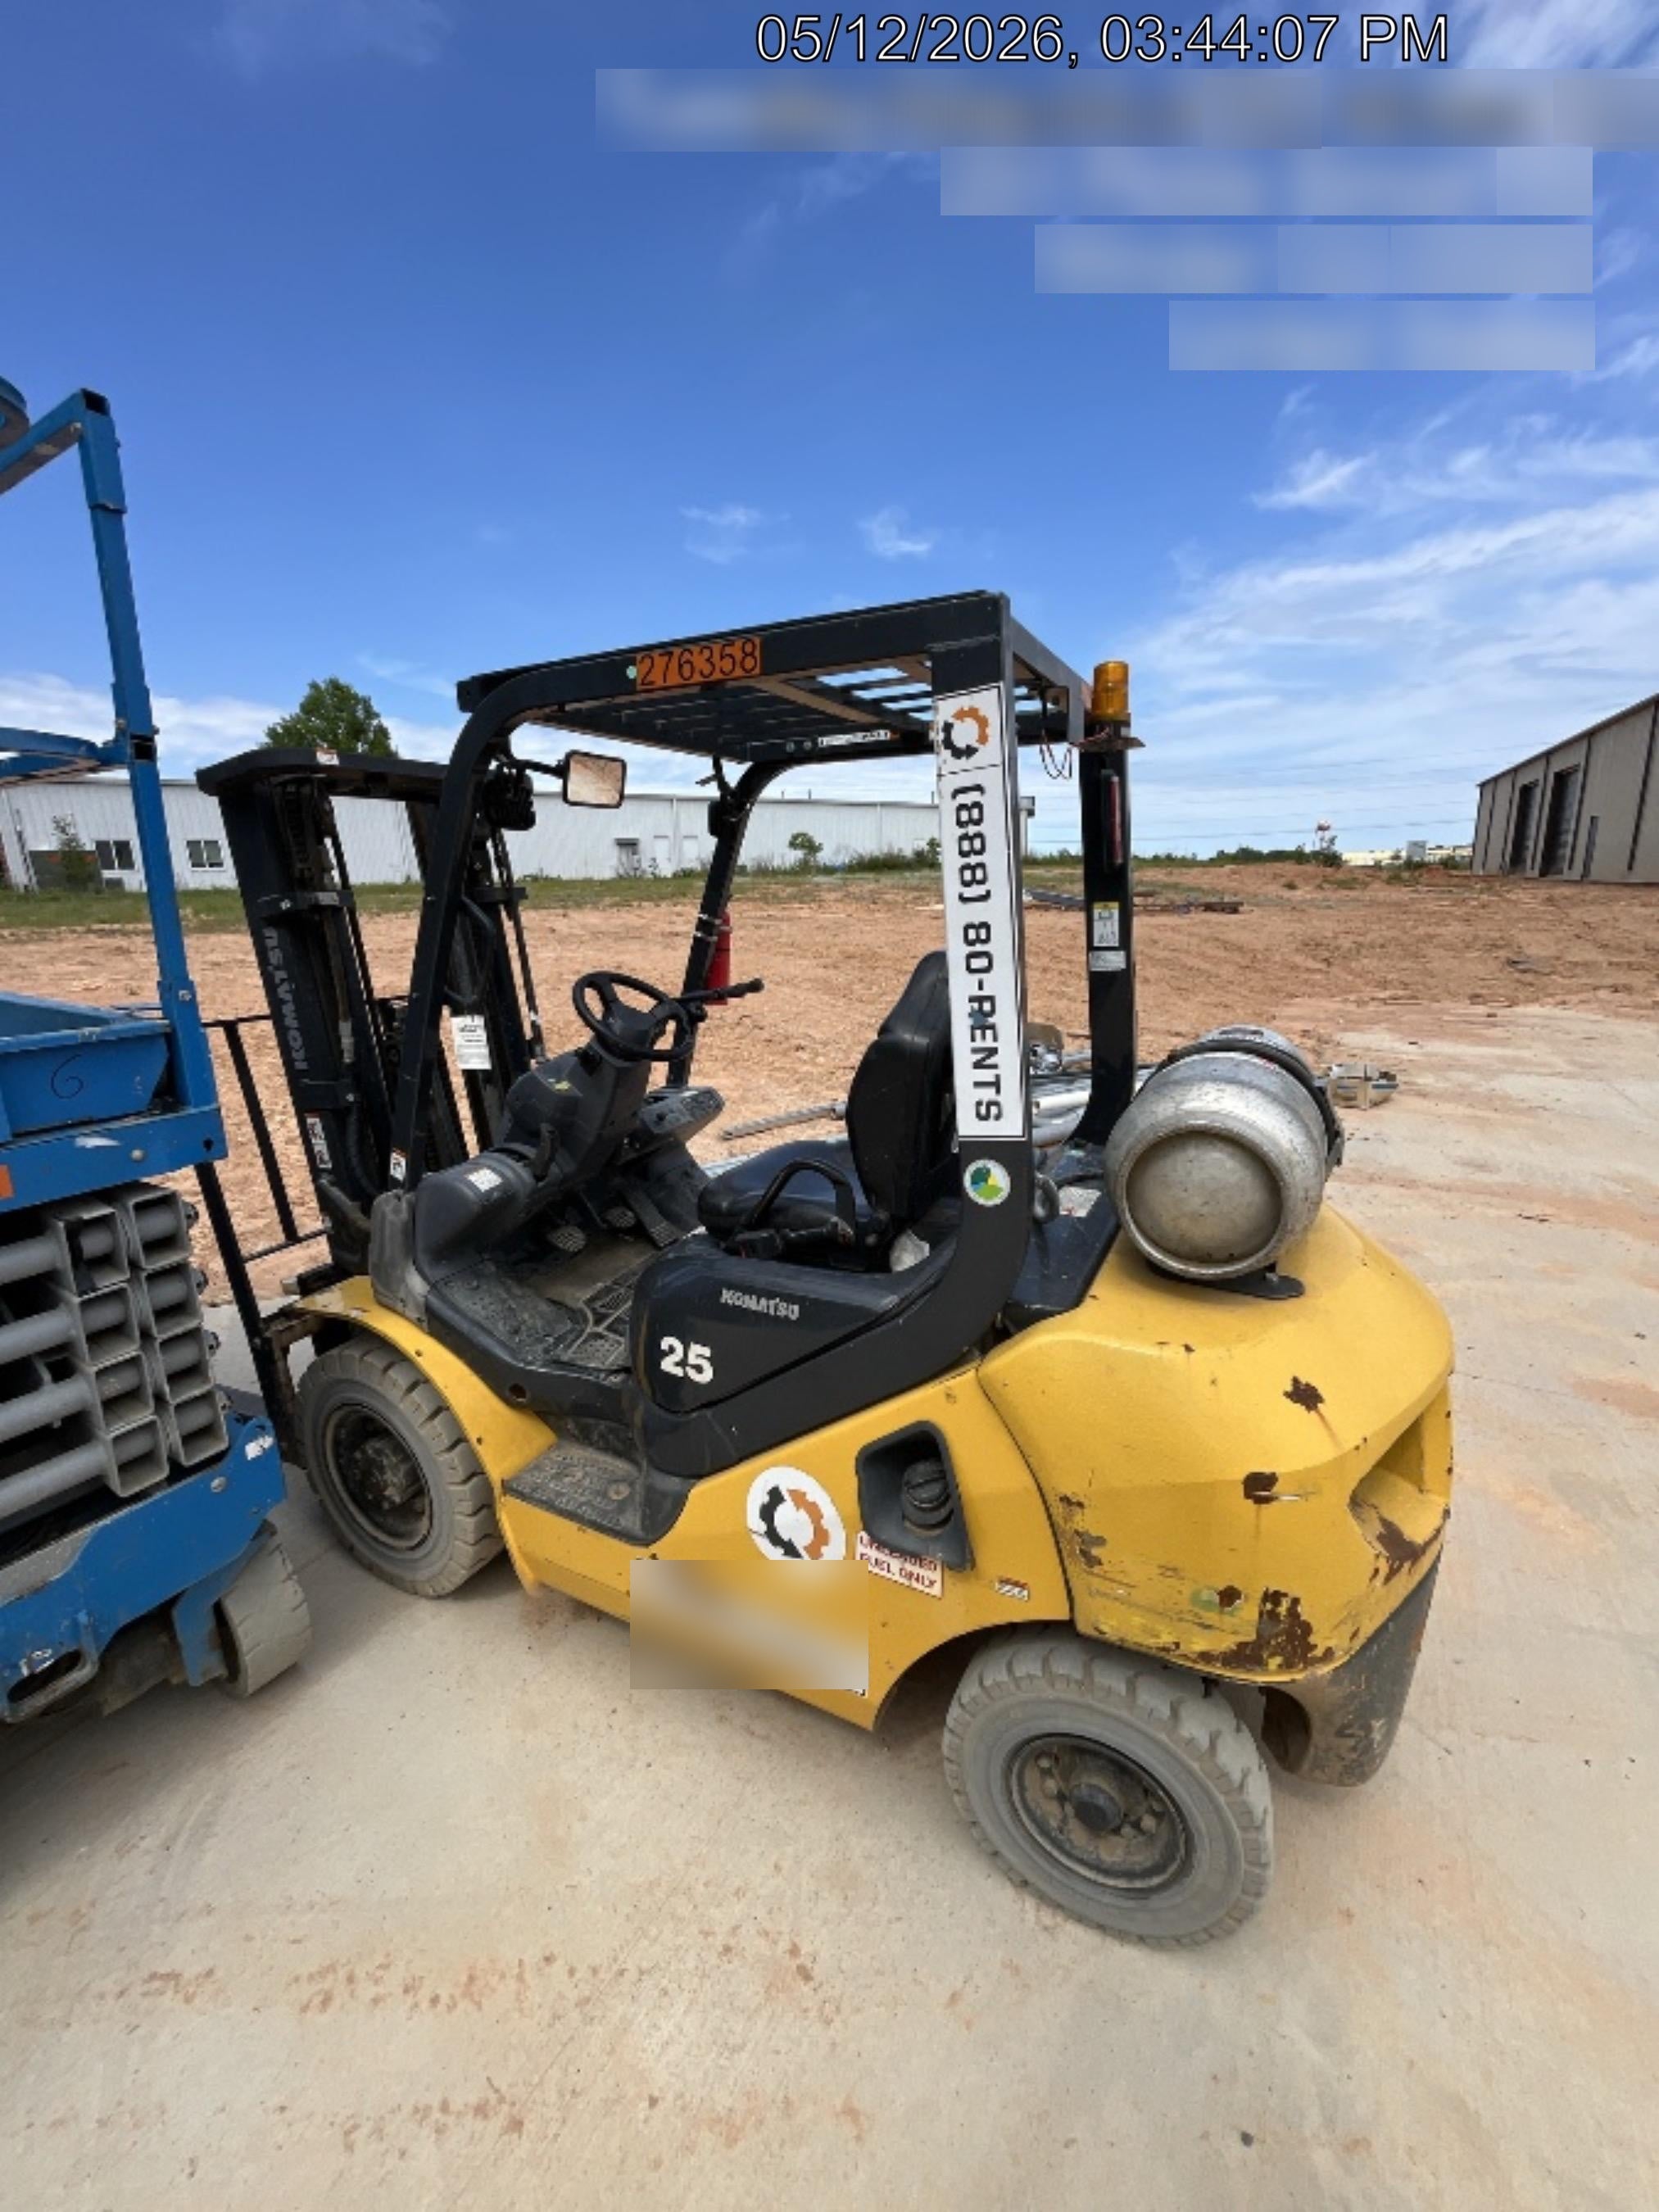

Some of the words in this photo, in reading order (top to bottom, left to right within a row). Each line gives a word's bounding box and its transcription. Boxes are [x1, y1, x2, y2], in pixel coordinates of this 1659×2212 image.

[638, 638, 758, 686] 276358
[951, 783, 992, 904] (888)
[963, 921, 1004, 1122] 80-RENTS
[720, 1287, 800, 1321] KOMATSU
[660, 1336, 714, 1385] 25
